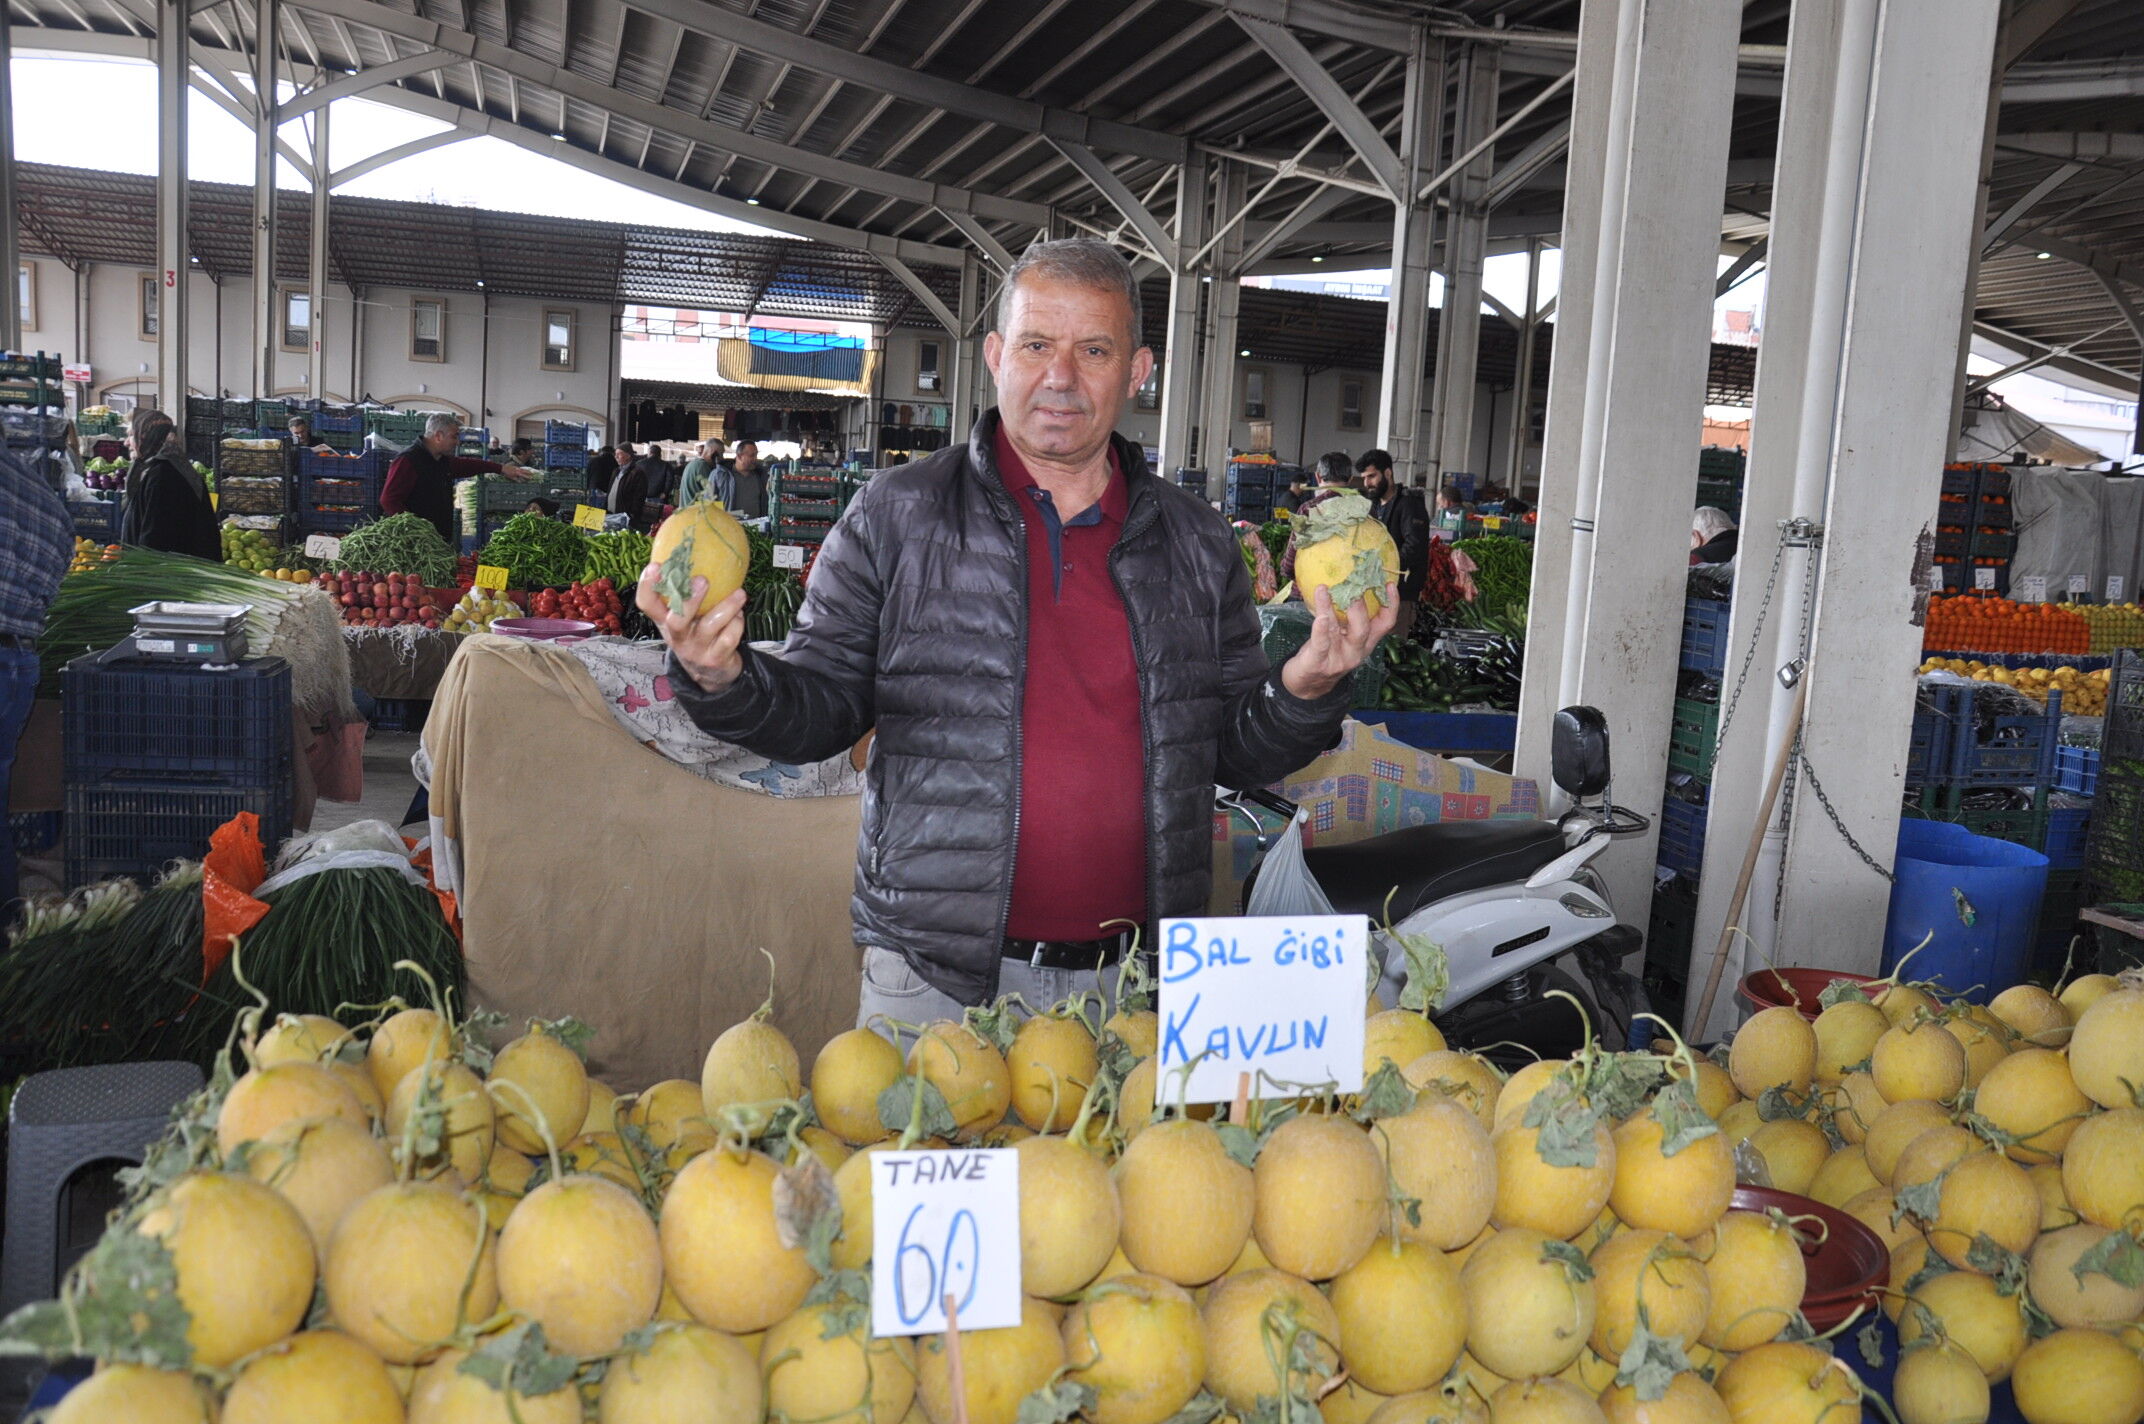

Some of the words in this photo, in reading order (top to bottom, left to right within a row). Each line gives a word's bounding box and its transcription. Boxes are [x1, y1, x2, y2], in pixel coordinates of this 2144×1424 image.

[166, 270, 176, 287] 3
[778, 548, 796, 563] 50
[478, 568, 504, 585] 100
[1163, 922, 1251, 983] BAL
[1162, 993, 1328, 1065] KAVUN
[883, 1154, 994, 1186] TANE
[894, 1203, 979, 1326] 60
